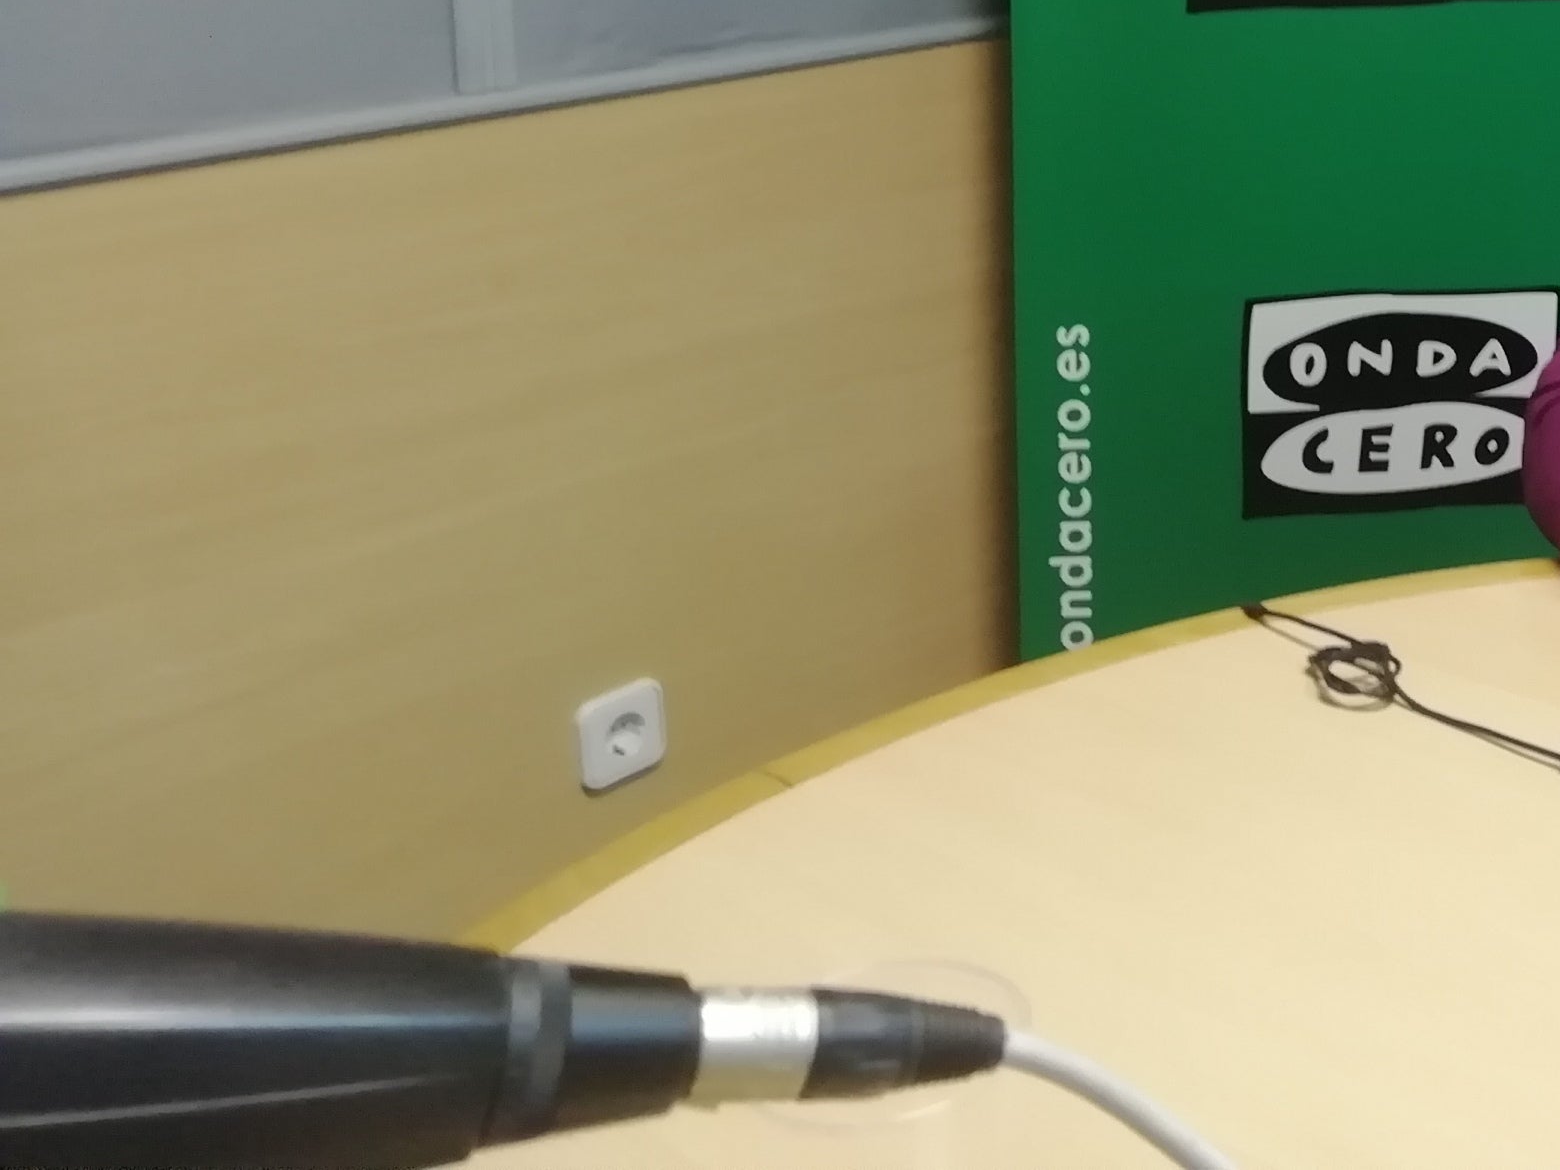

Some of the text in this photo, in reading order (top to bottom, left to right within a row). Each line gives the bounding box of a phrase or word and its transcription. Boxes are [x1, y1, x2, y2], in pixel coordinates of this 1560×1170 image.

[1290, 339, 1511, 388] ONDA
[1302, 425, 1510, 474] CERO
[1048, 323, 1094, 652] ondacero.es
